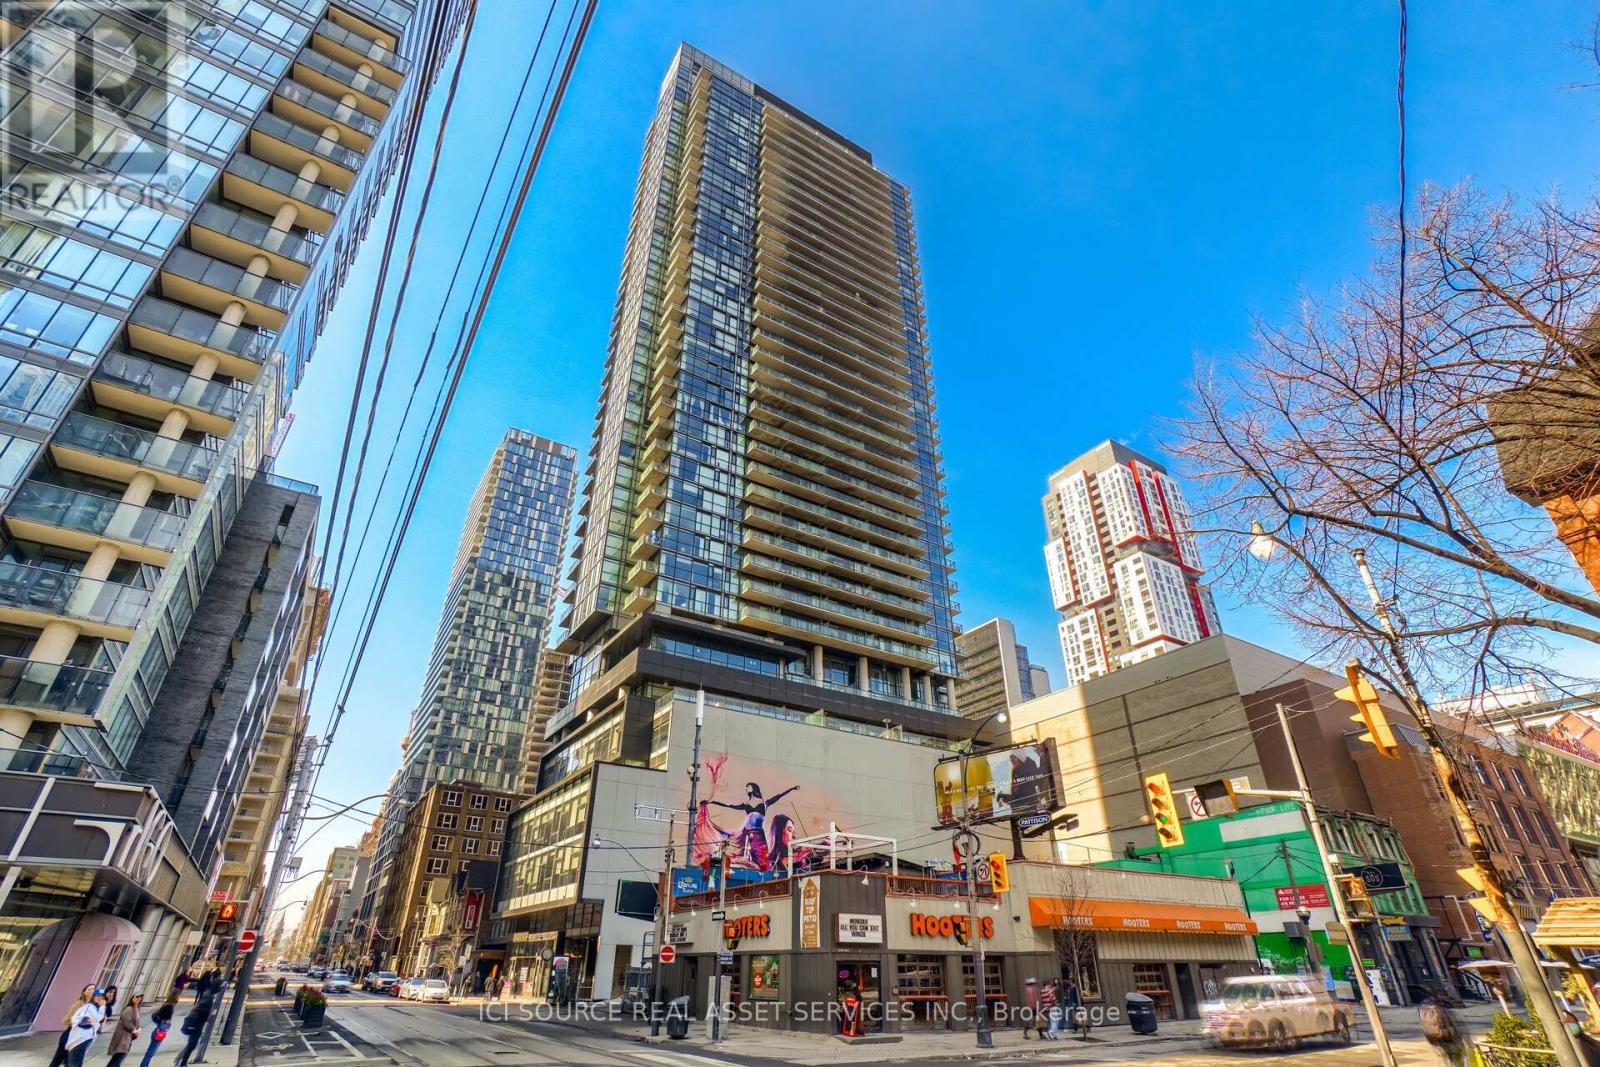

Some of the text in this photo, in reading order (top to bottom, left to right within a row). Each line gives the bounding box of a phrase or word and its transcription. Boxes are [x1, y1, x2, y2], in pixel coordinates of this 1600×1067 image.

[1020, 816, 1048, 826] PATTISON
[723, 914, 771, 939] OTERS
[911, 912, 994, 938] HOOS
[1122, 917, 1151, 928] HOOTERS
[1176, 920, 1201, 929] HOOTERS
[1224, 922, 1247, 931] HOOTERS
